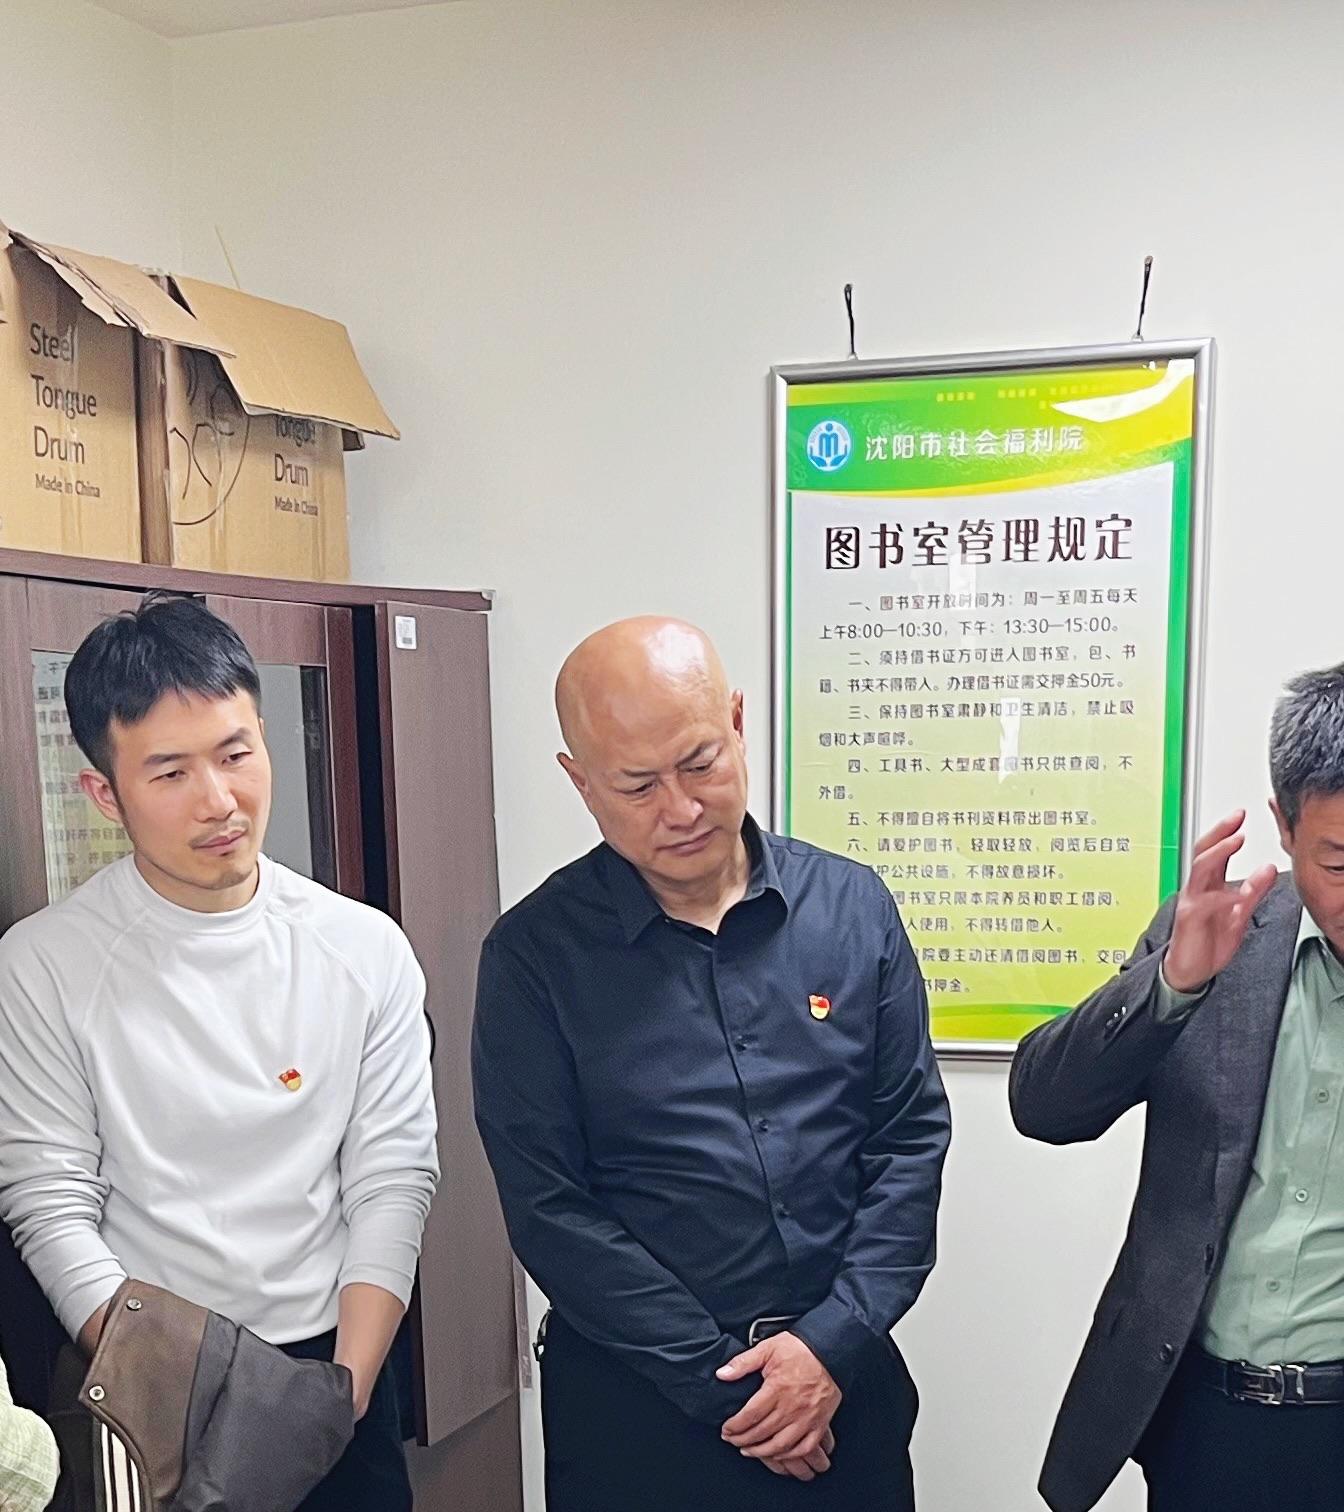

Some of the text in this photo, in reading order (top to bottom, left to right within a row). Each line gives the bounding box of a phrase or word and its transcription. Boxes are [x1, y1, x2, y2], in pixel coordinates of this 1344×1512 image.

[30, 322, 74, 362] Steel
[30, 373, 97, 420] Tongue
[34, 425, 85, 465] Drum
[866, 426, 1085, 461] 沈阳市社会福利院
[35, 473, 63, 493] Made
[274, 453, 309, 487] Drum
[824, 513, 1134, 571] 图书室管理规定
[870, 864, 1064, 880] 护公共设施，不得故意损坏。
[914, 947, 1126, 965] 院要主动还清借阅图书，交回
